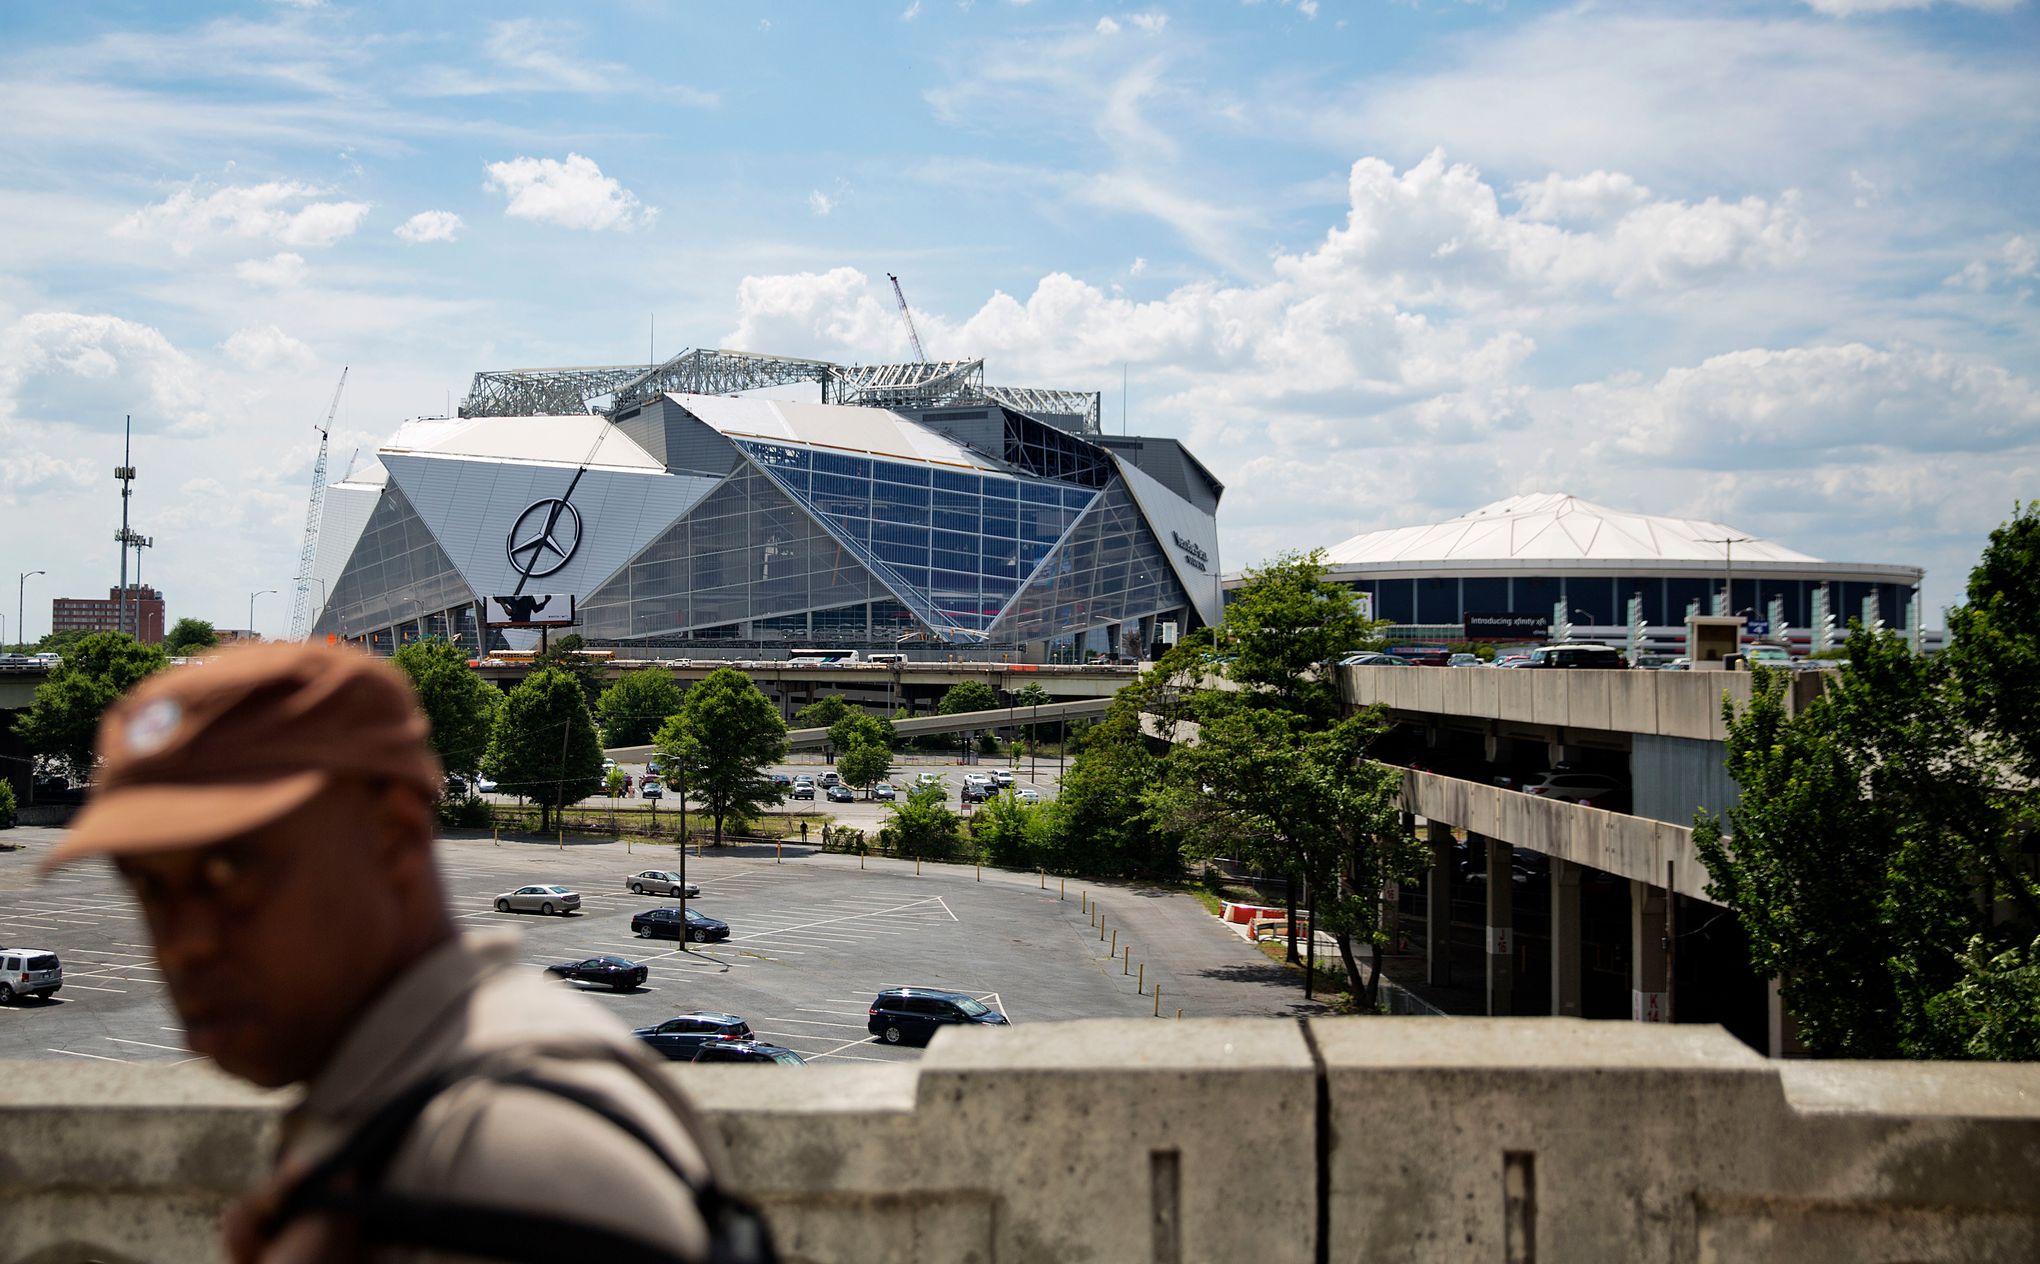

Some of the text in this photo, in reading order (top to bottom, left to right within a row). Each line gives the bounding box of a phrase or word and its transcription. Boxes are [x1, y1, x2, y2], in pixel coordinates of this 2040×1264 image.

[1471, 617, 1512, 626] Introducing
[1514, 617, 1534, 626] xfinity
[1650, 993, 1658, 1008] K
